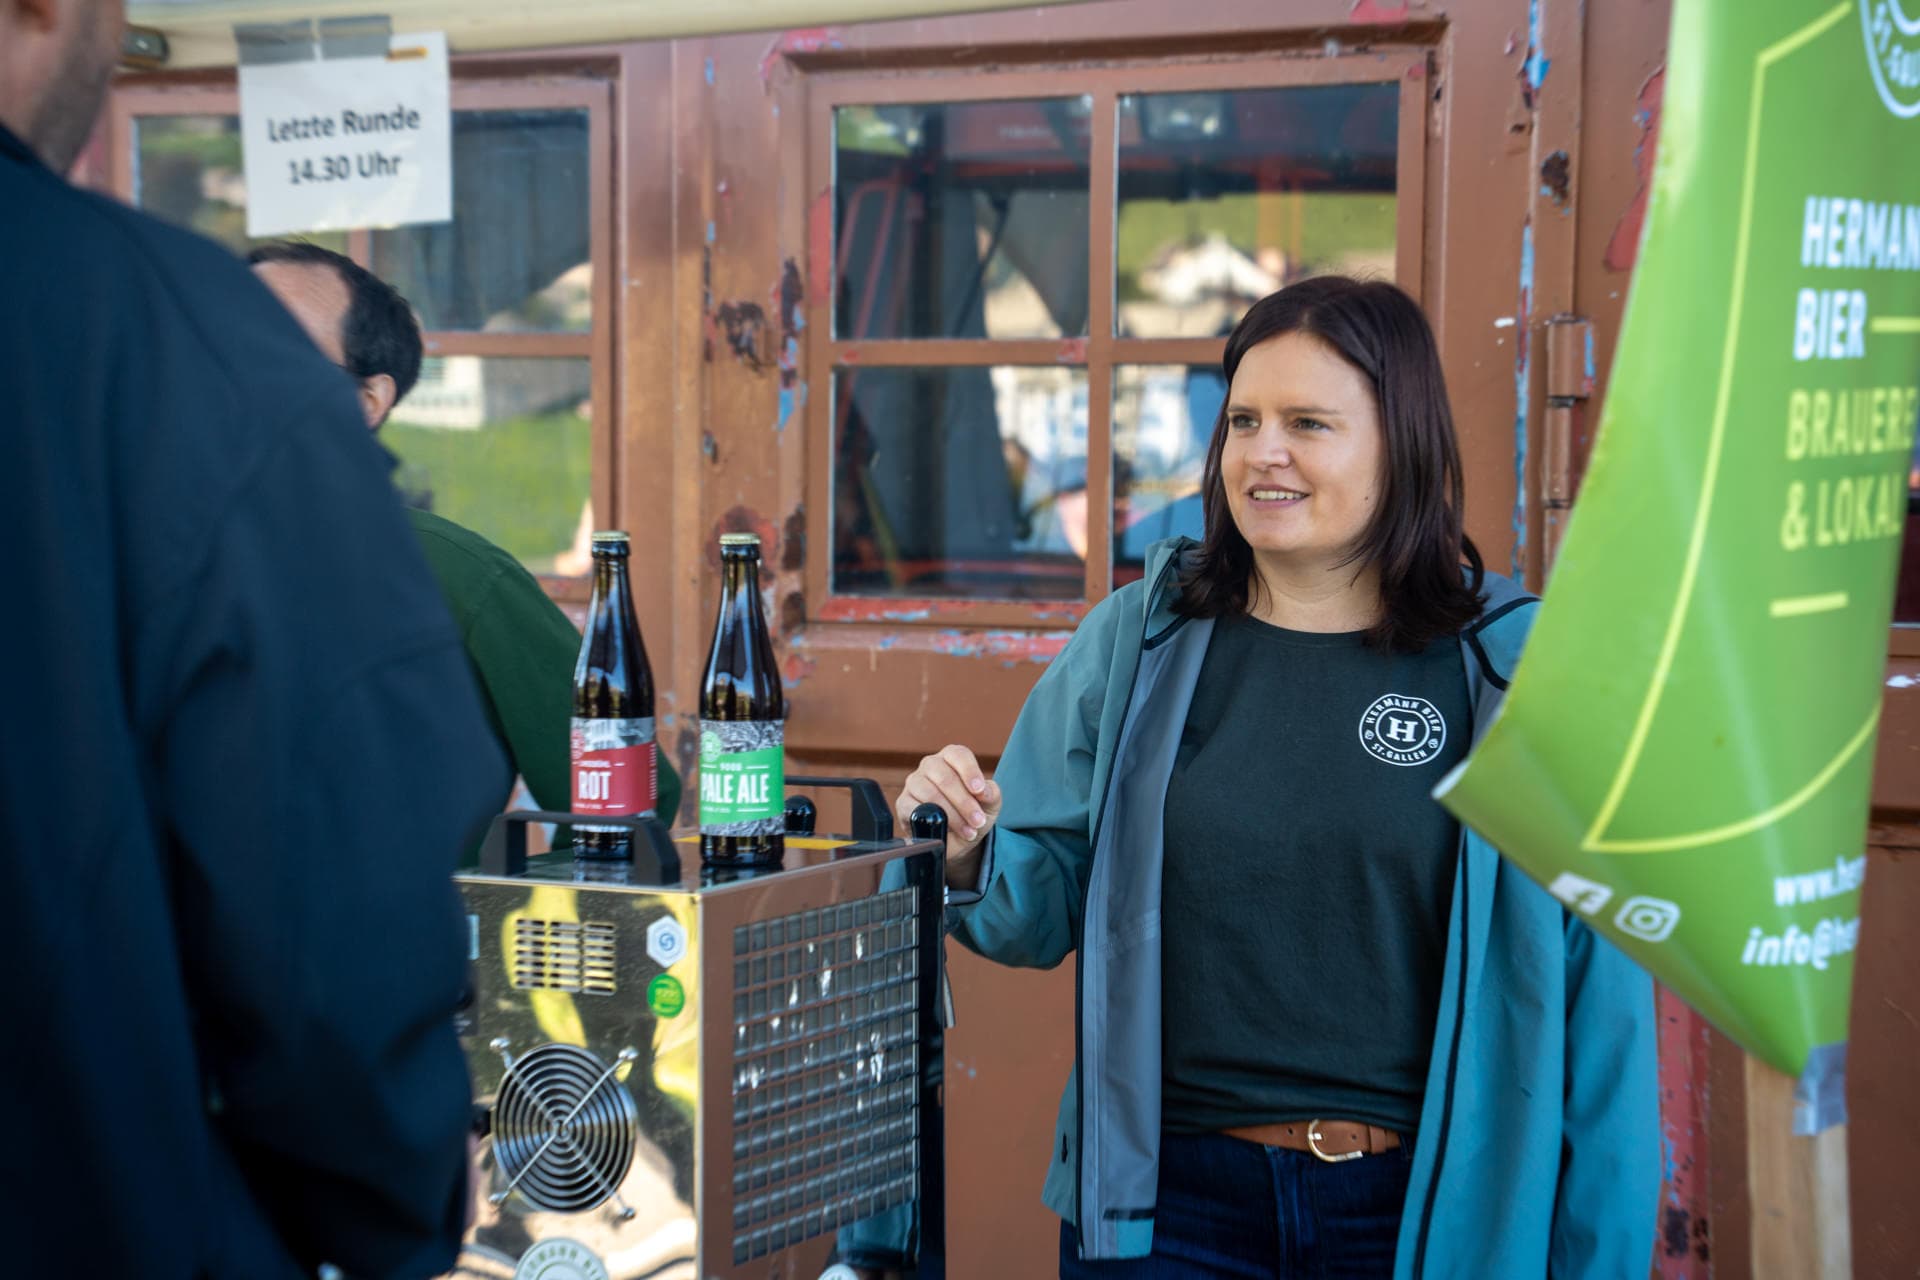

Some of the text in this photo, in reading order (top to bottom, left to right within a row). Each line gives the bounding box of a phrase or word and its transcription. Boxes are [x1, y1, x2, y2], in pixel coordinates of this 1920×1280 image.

[267, 104, 420, 142] Letzte Runde
[289, 152, 402, 184] 14.30 Uhr
[1793, 287, 1868, 361] BIER
[1780, 480, 1809, 551] &
[1365, 697, 1442, 732] HERMANN BIER
[1386, 716, 1418, 743] H
[578, 770, 612, 801] ROT
[701, 773, 769, 803] PALE ALE
